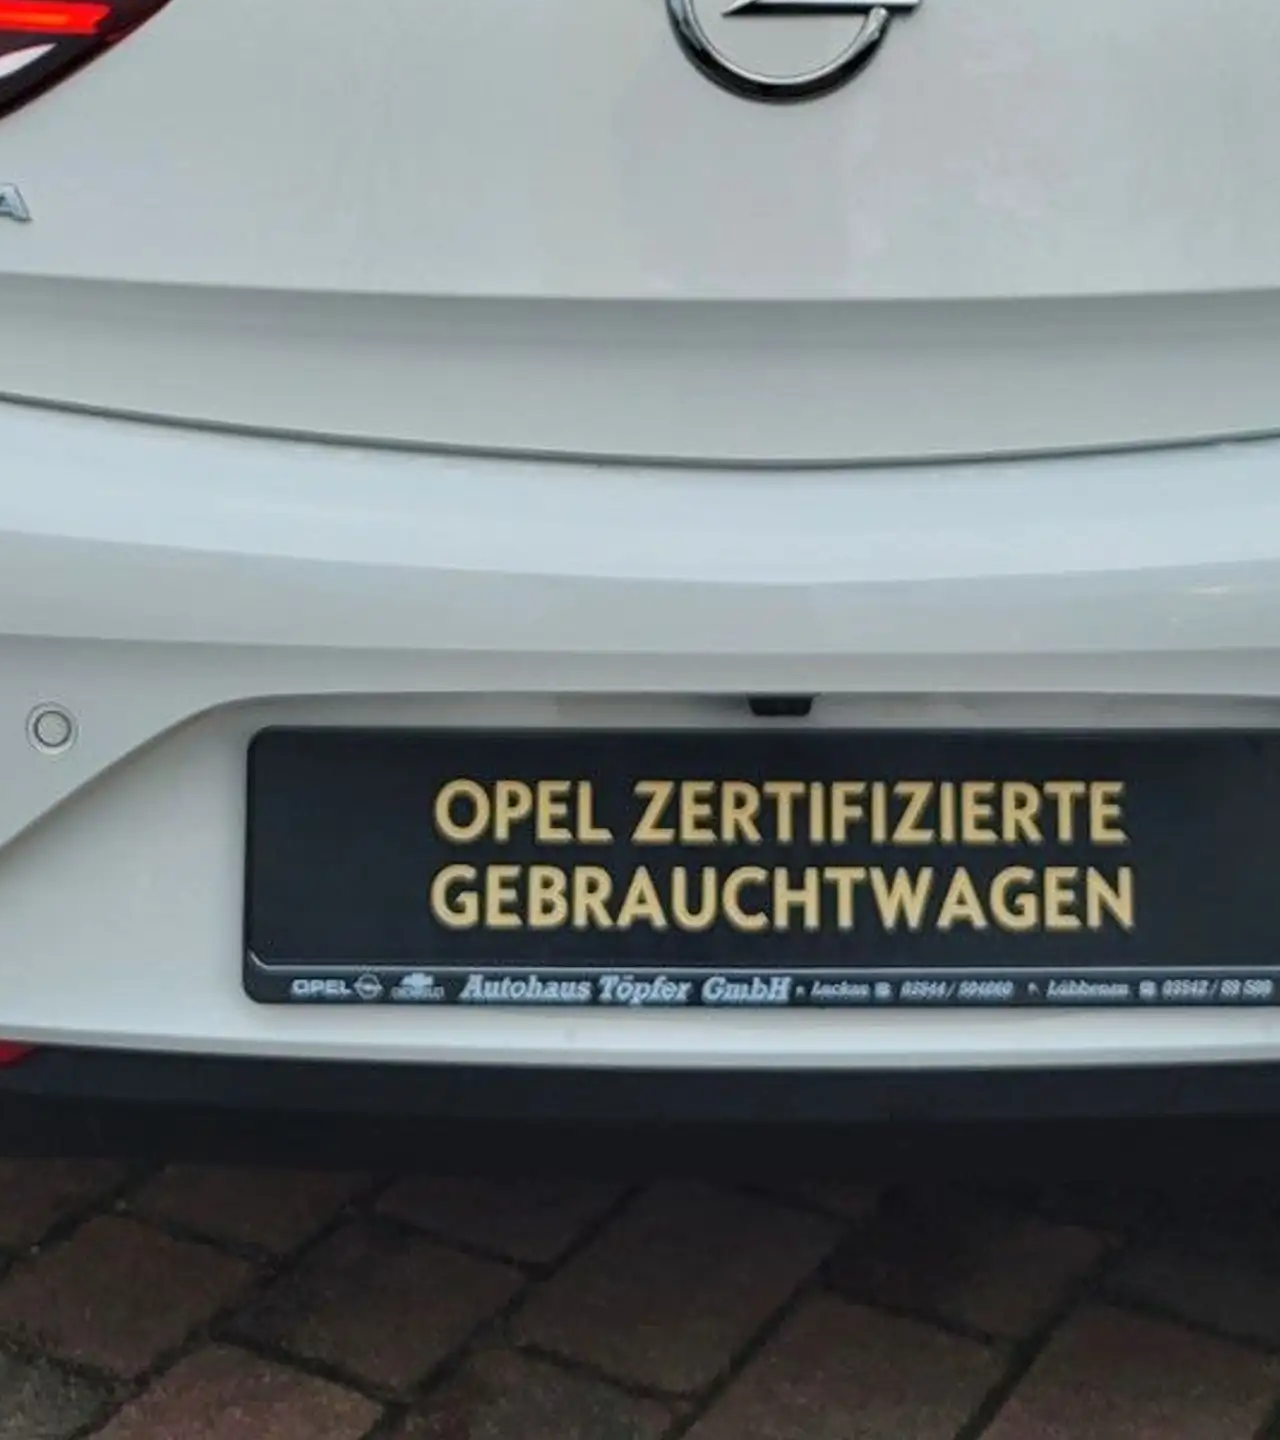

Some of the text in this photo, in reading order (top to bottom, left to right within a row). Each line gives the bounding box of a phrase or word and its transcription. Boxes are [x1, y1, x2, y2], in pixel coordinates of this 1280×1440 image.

[435, 779, 1127, 844] OPEL ZERTIFIZIERTE
[431, 865, 1134, 929] GEBRAUCHTWAGEN
[292, 979, 352, 995] OPEL
[459, 974, 591, 1000] Autohaus
[598, 975, 692, 1005] Töpfer
[701, 976, 793, 1001] GmbH
